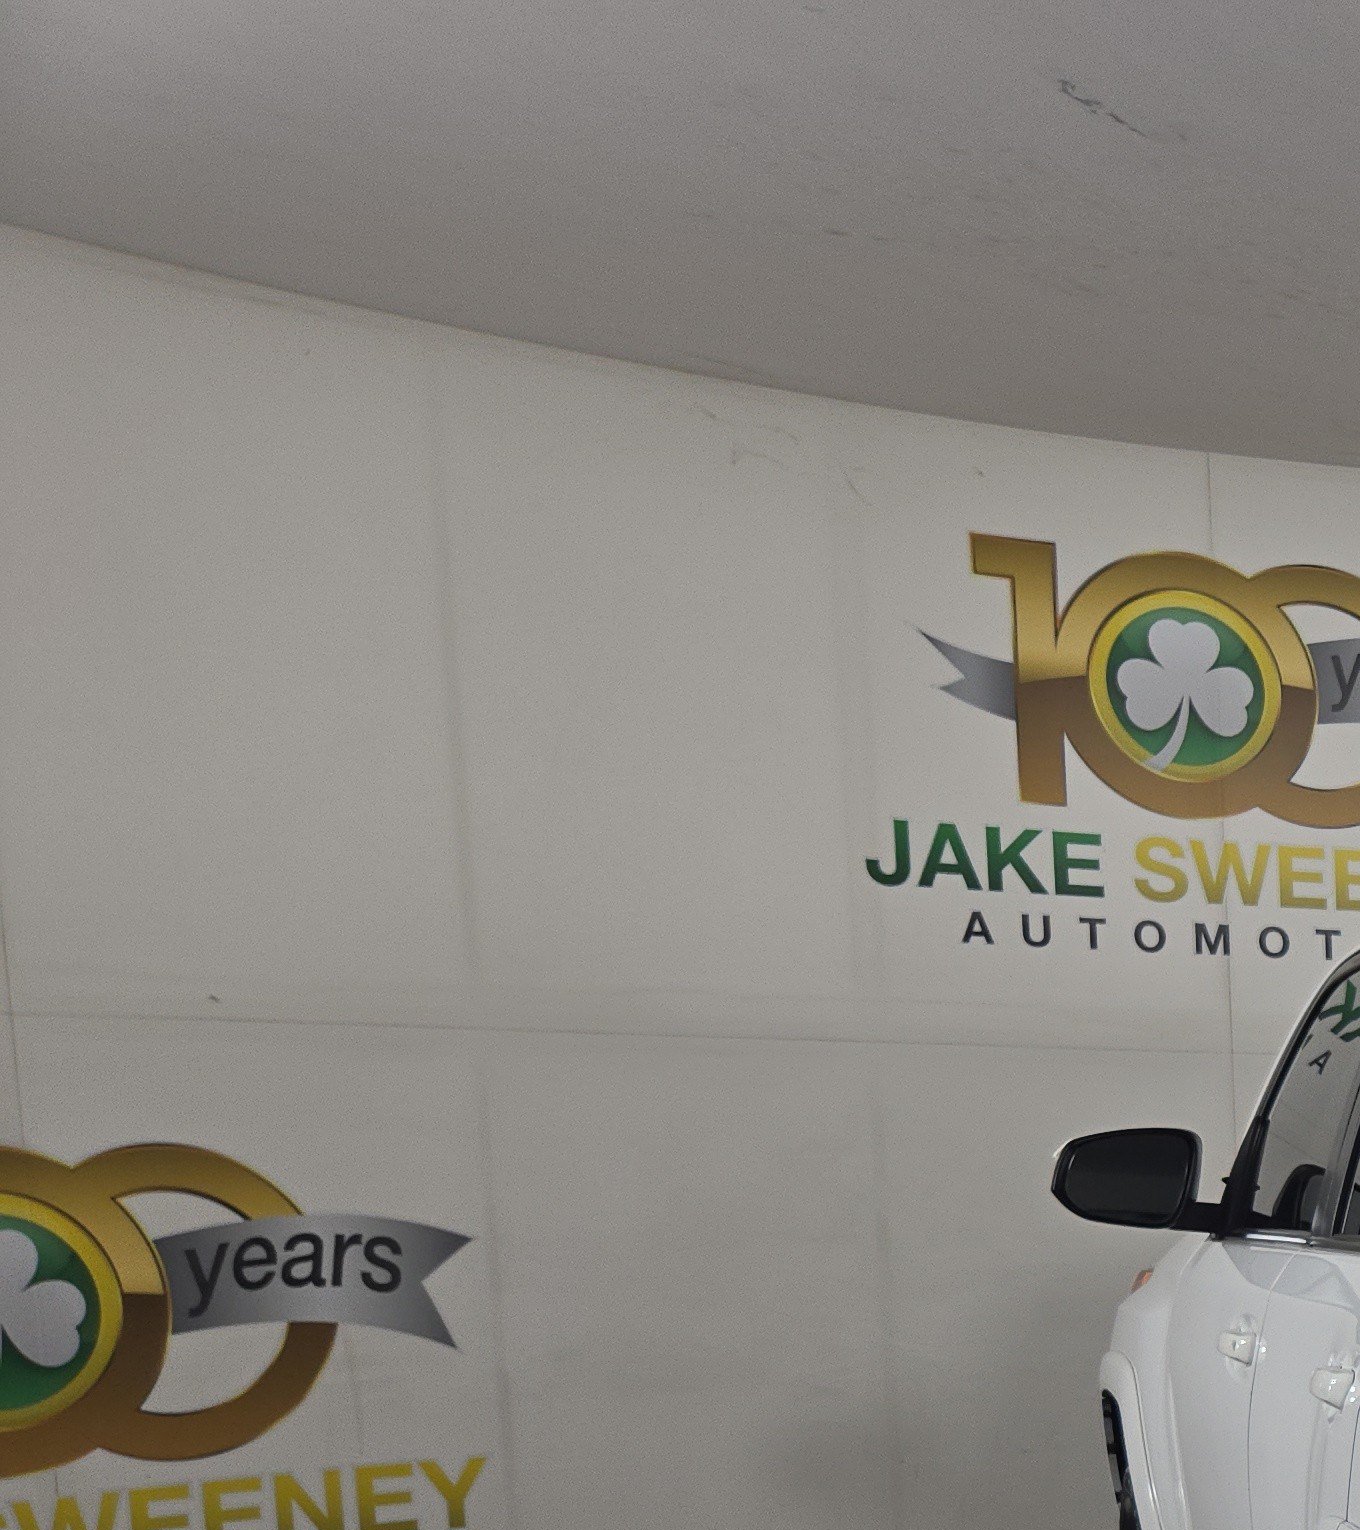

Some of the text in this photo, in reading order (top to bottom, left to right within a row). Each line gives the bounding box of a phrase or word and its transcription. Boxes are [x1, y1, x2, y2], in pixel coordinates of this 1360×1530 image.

[866, 818, 1105, 898] JAKE
[962, 910, 1342, 961] AUTOMOT
[183, 1231, 402, 1317] years
